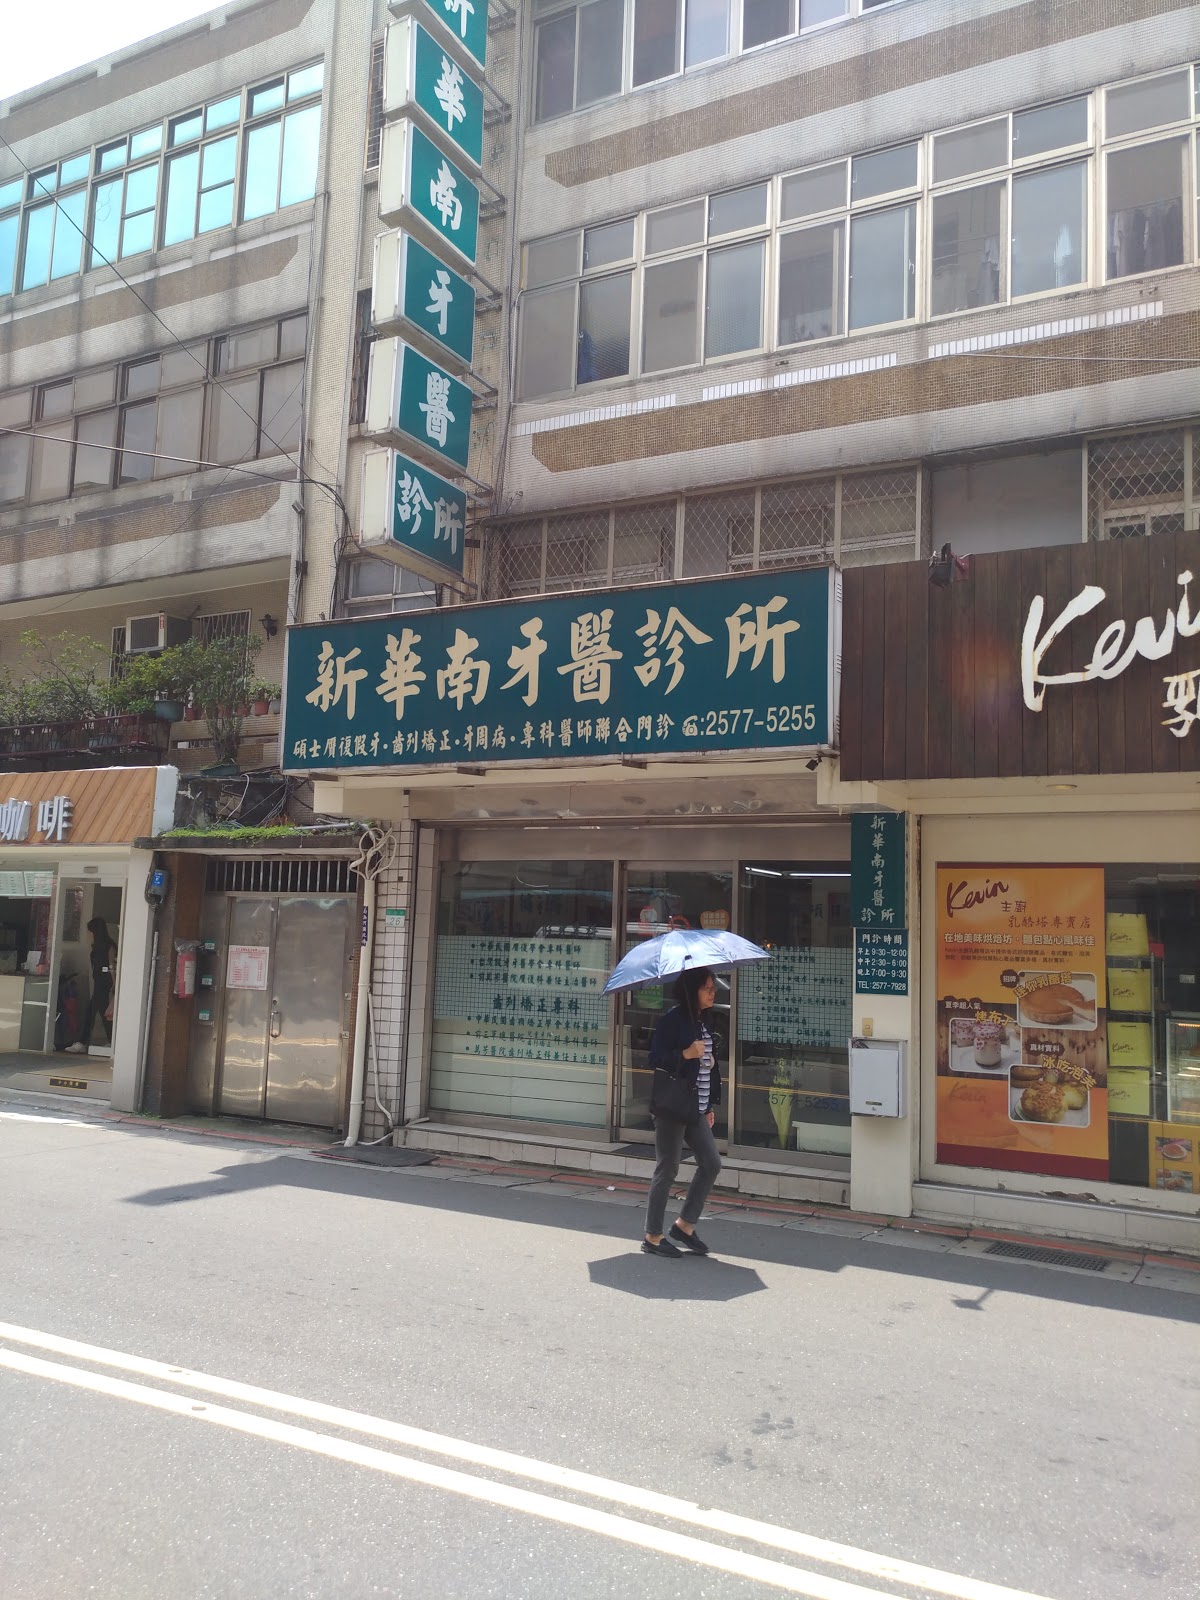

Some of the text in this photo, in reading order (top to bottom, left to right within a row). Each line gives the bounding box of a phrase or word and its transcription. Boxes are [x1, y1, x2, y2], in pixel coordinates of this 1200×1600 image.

[304, 595, 801, 722] 新華南牙醫診所
[946, 878, 1009, 918] Kevin
[862, 933, 902, 945] 門診時間
[1013, 971, 1072, 998] 迷你乳酪塔
[974, 1010, 1014, 1027] 烤布丁
[1029, 1043, 1060, 1052] 真材實料
